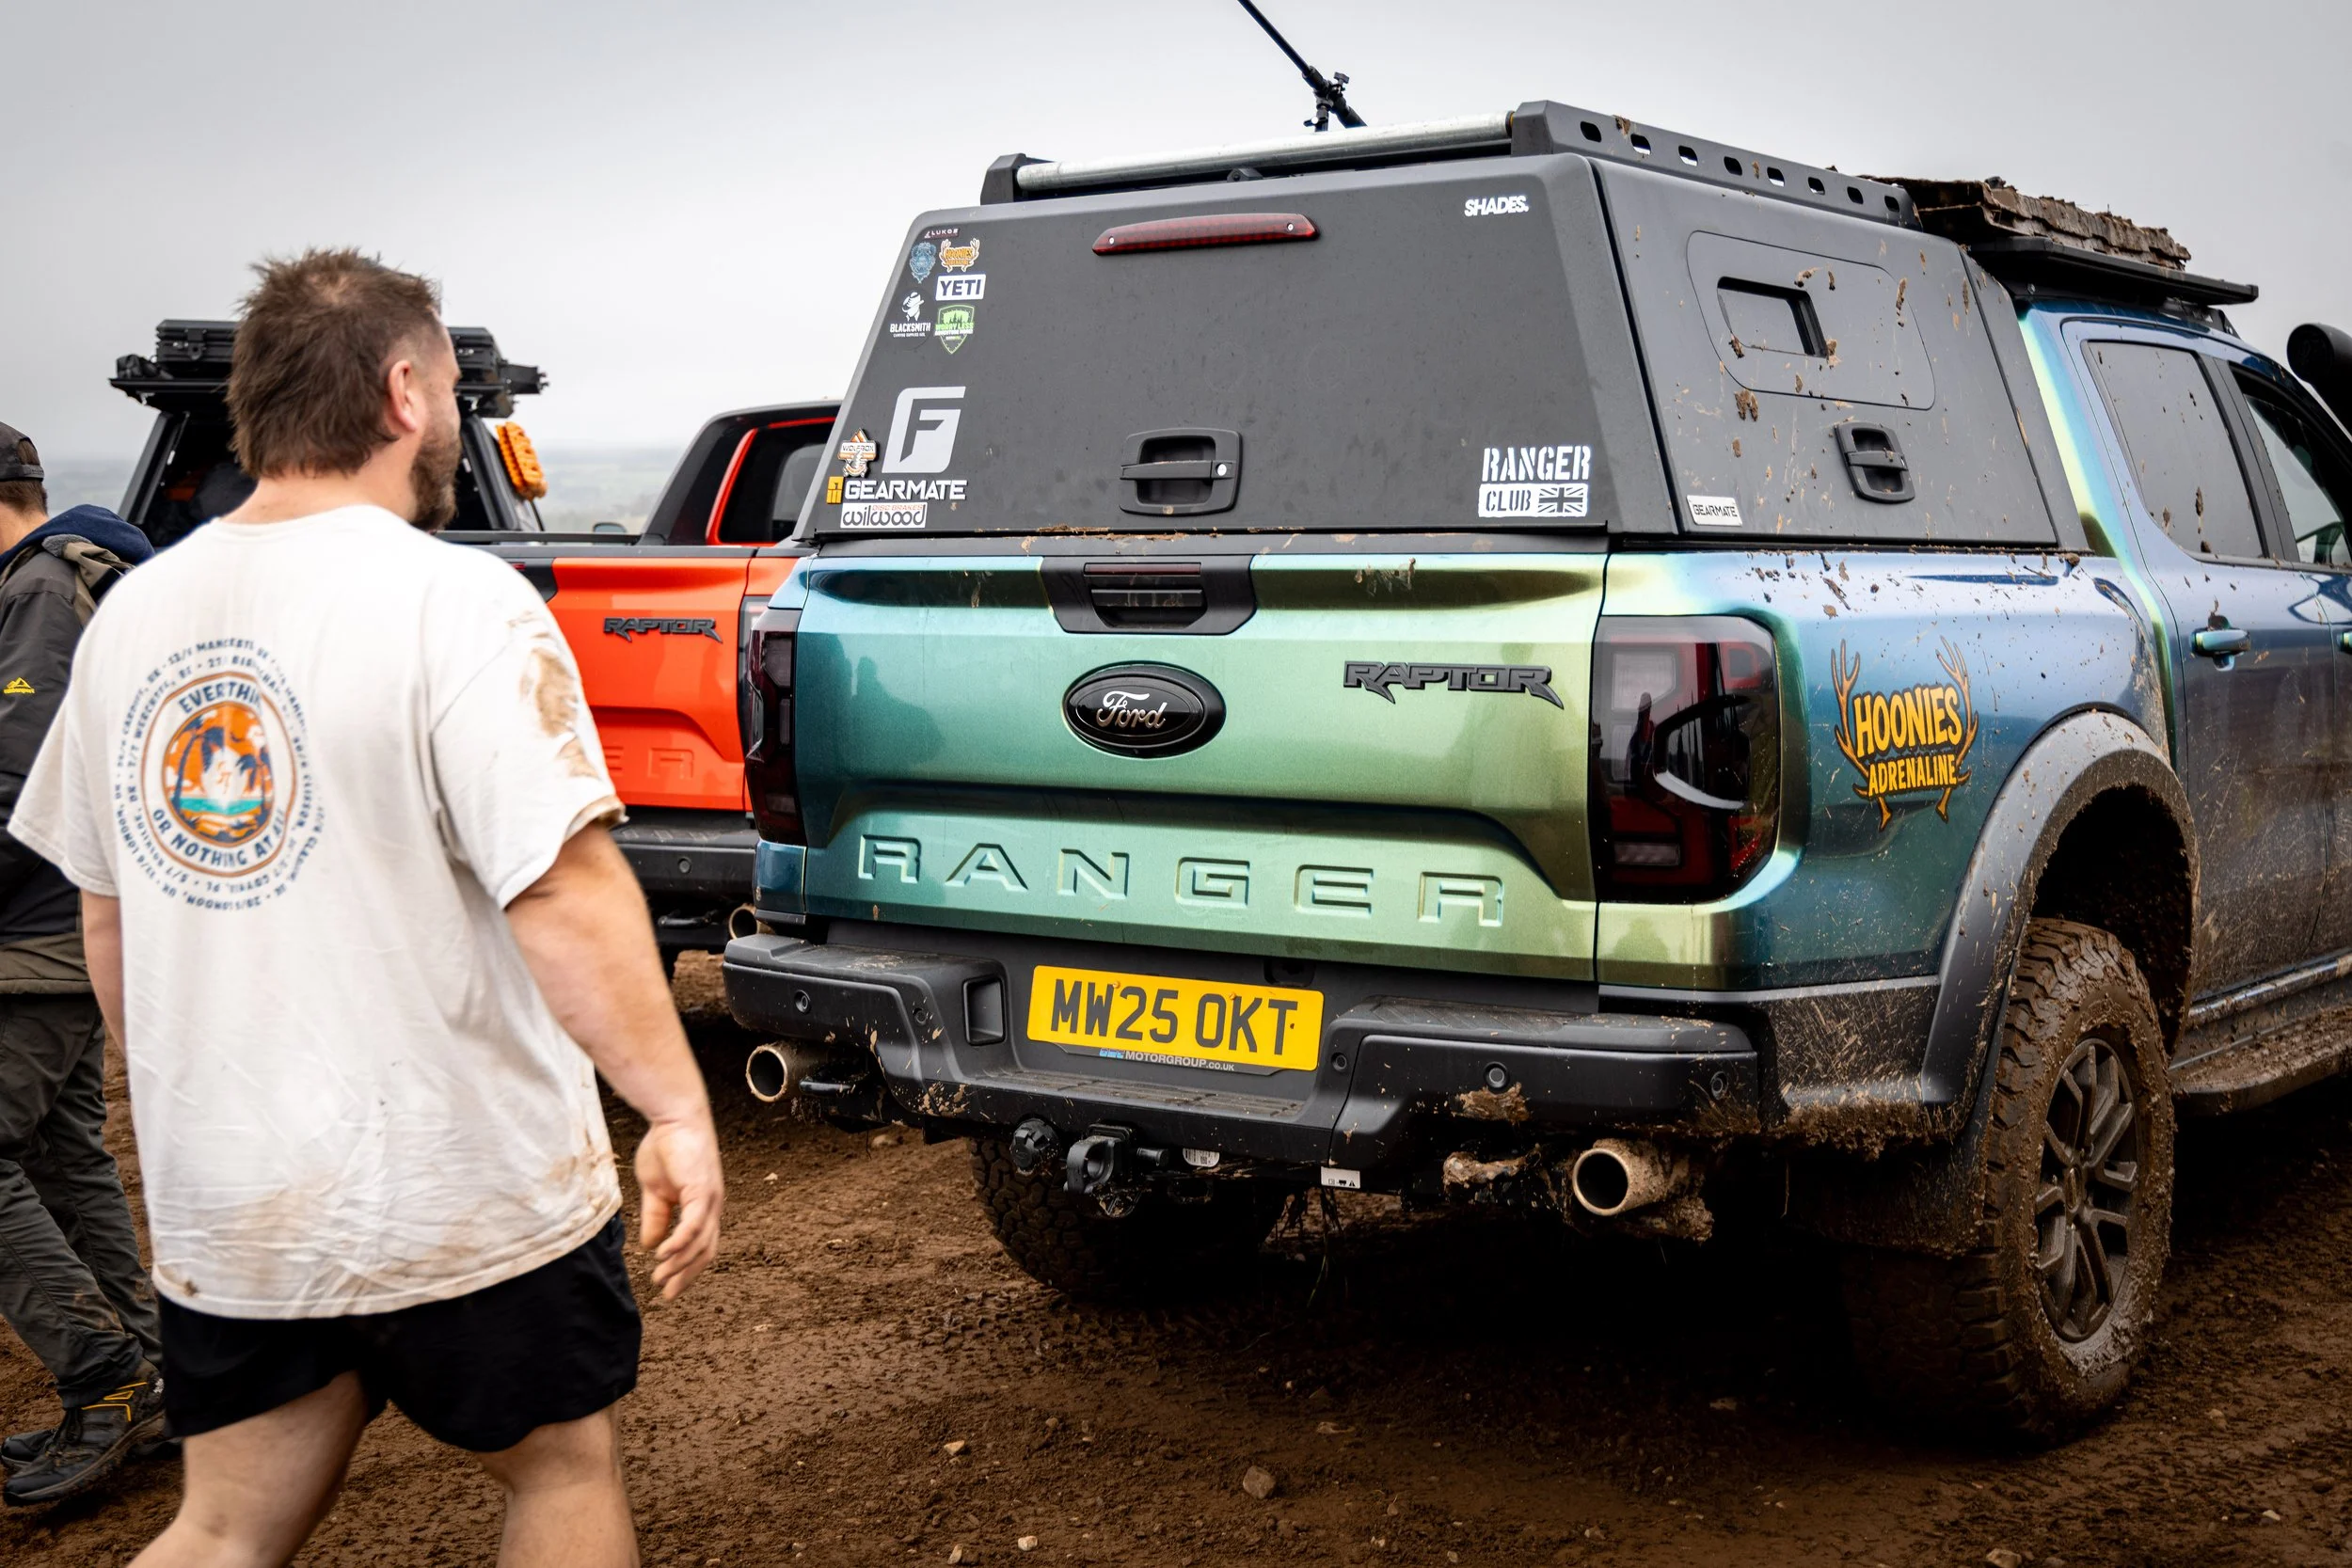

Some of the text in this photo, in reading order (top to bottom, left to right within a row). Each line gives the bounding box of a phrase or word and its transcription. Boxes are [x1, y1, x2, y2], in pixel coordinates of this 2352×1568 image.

[1464, 195, 1530, 217] SHADES.
[940, 277, 981, 296] YETI
[890, 323, 931, 333] BLACKSMITH
[958, 322, 974, 330] LESS
[843, 444, 874, 452] WOLFBOX
[1481, 445, 1592, 483] RANGER
[845, 480, 968, 500] GEARMATE
[1486, 488, 1533, 513] CLUB
[843, 504, 927, 526] wilwood
[1692, 504, 1738, 517] GEARMATE
[604, 617, 723, 643] RAPTOR
[1343, 659, 1564, 711] RAPTOR
[1095, 689, 1168, 729] Ford
[1853, 686, 1963, 758] HOONIES
[1867, 753, 1959, 798] ADRENALINE
[152, 809, 172, 833] OR
[254, 835, 274, 858] AT
[857, 832, 1505, 928] RANGER
[1050, 978, 1299, 1056] MW25 OKT
